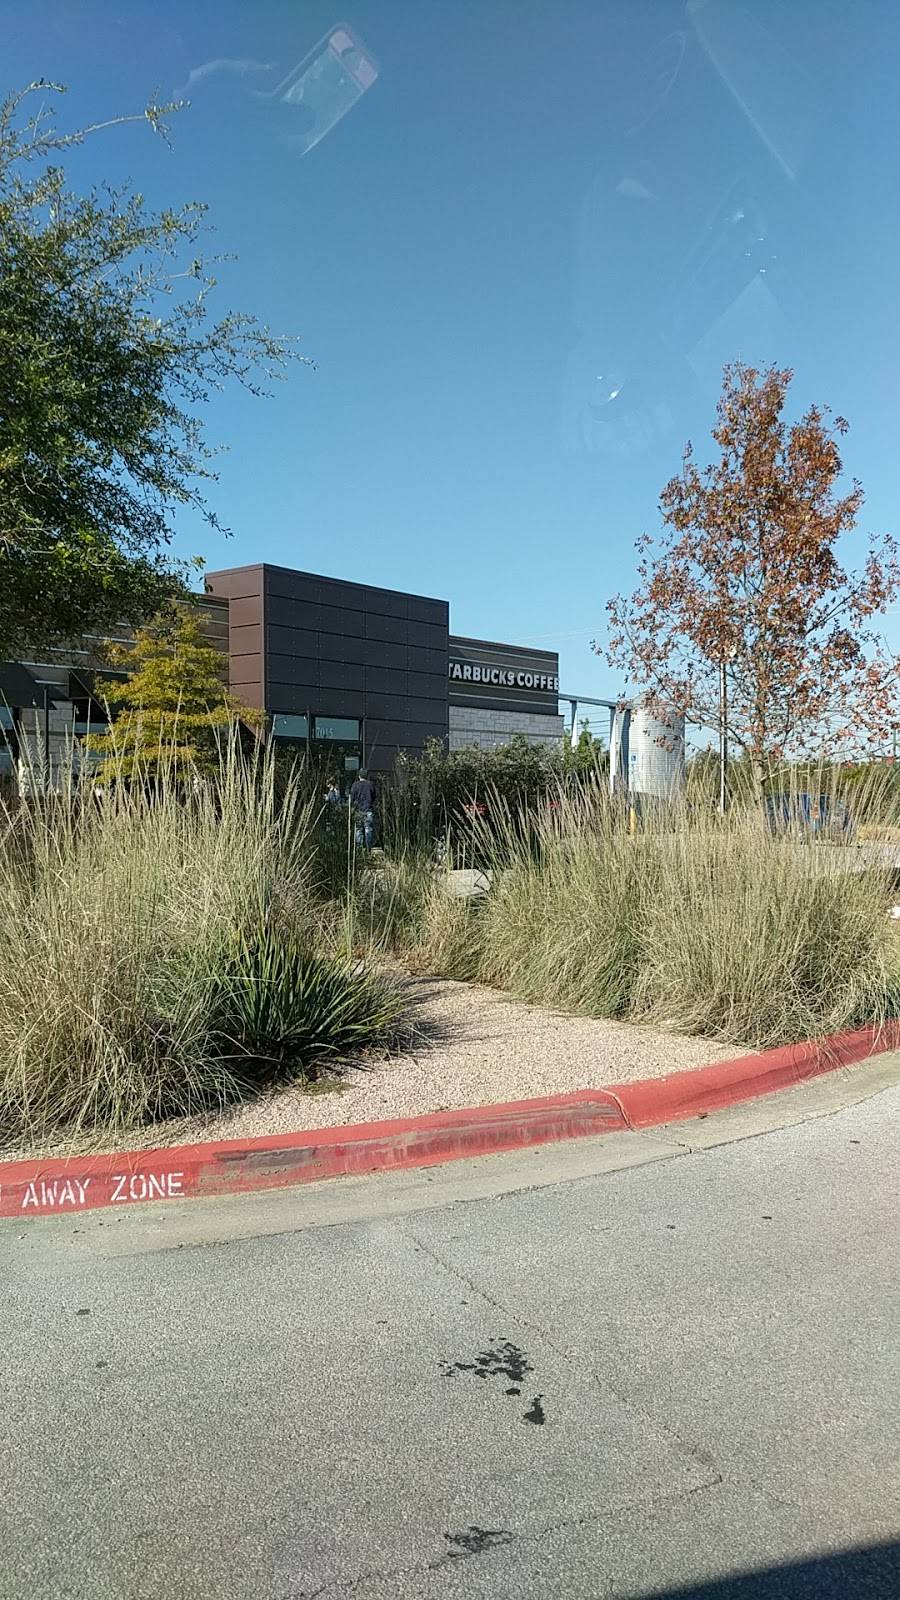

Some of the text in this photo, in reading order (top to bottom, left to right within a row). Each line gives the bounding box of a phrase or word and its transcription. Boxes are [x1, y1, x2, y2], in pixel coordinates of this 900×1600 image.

[516, 671, 560, 691] COFFEE
[21, 1178, 91, 1208] AWAY
[110, 1172, 185, 1201] ZONE
